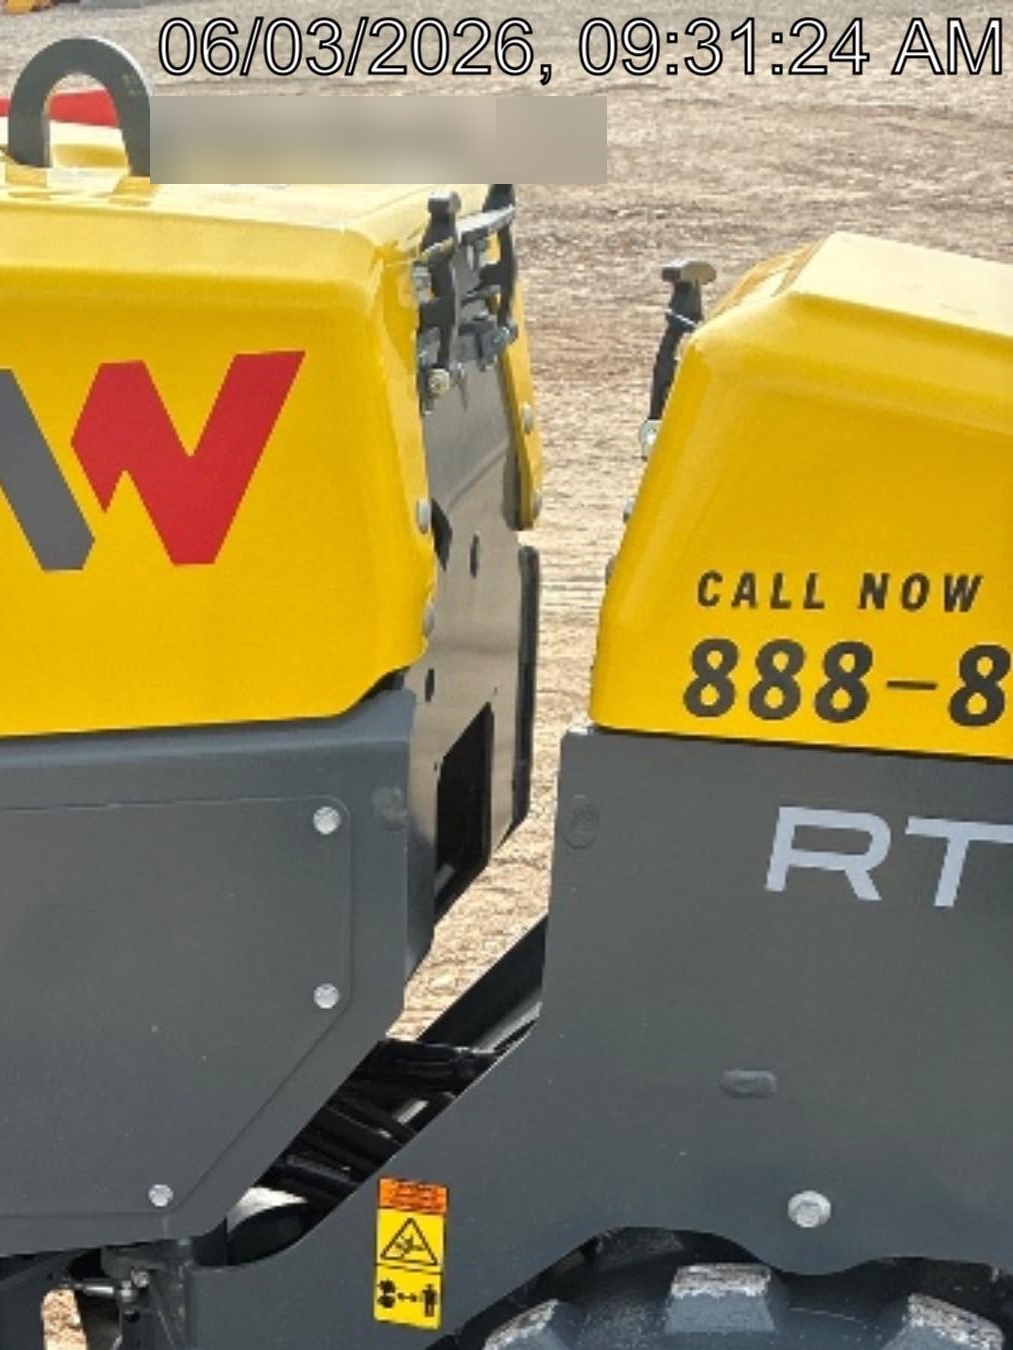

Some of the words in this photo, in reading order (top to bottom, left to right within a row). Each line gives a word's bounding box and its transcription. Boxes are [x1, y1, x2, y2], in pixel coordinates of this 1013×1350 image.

[697, 570, 825, 610] CALL
[858, 573, 983, 613] NOW
[683, 638, 1012, 727] 888-8
